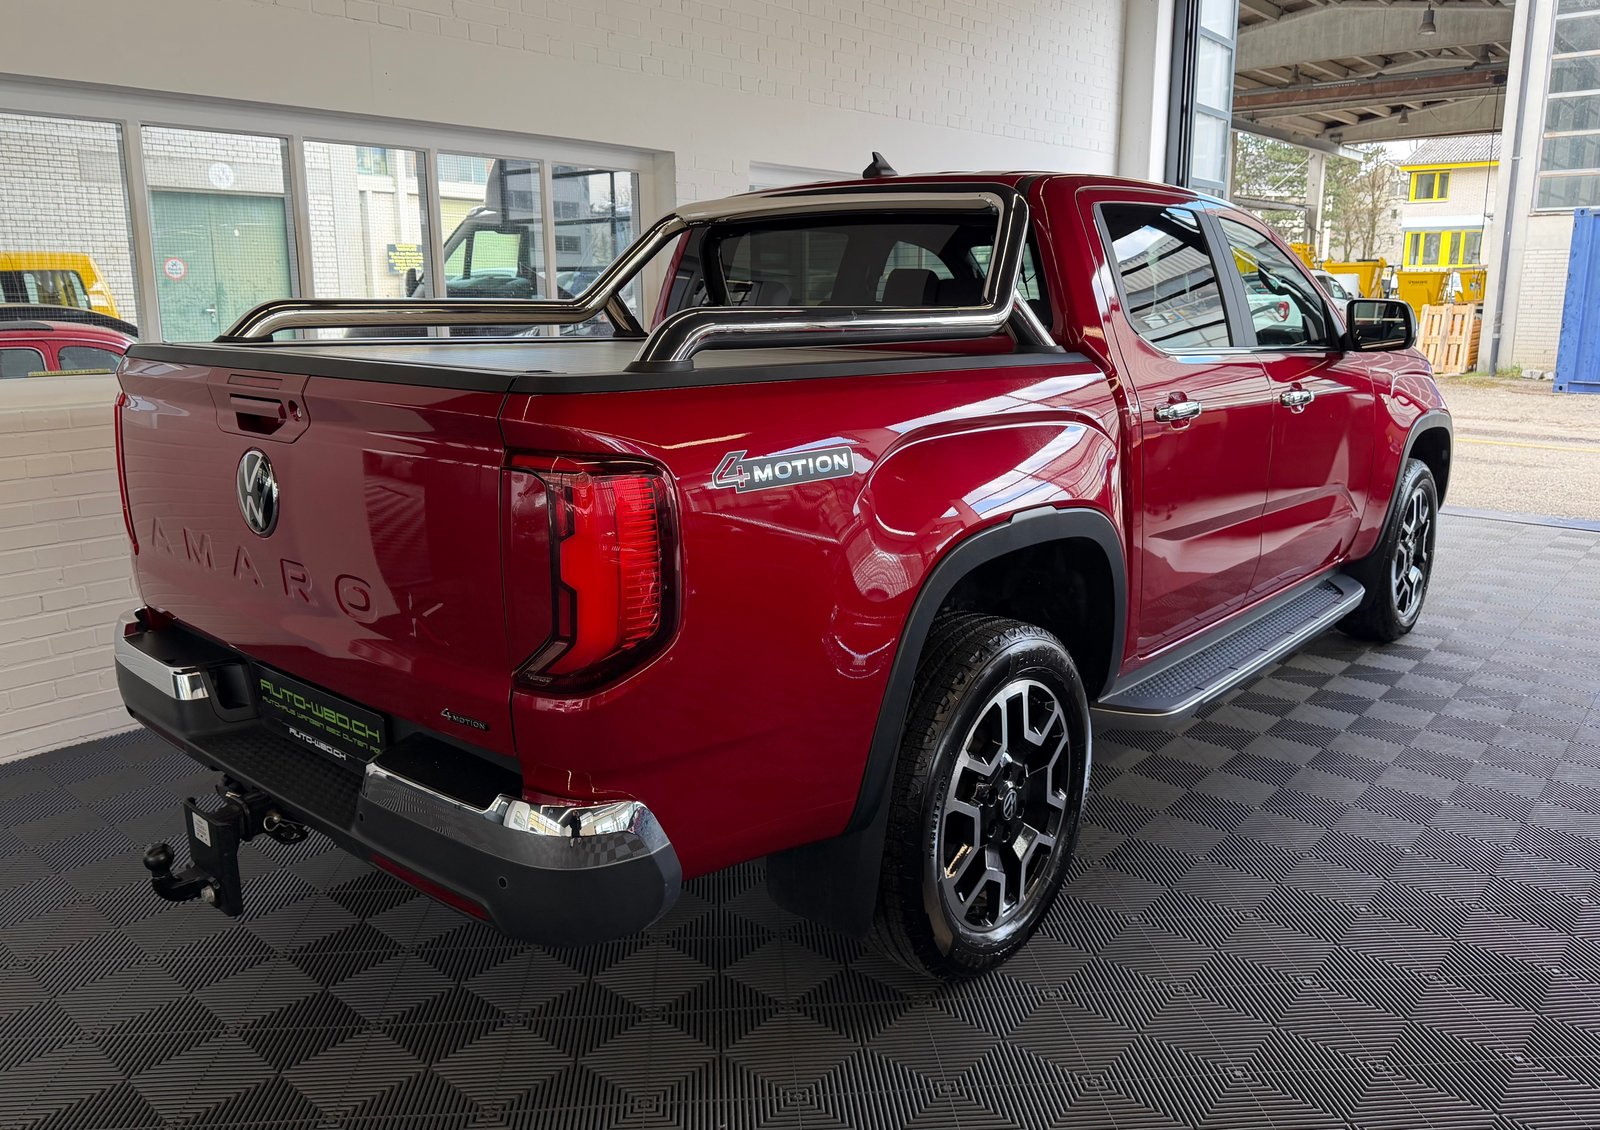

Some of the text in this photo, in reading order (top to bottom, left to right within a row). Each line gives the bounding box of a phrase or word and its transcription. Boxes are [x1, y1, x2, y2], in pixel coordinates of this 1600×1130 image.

[152, 517, 449, 644] AMAROK
[262, 695, 296, 716] AUTOHAUS
[296, 711, 325, 729] WANGEN
[342, 732, 368, 749] OLTEN
